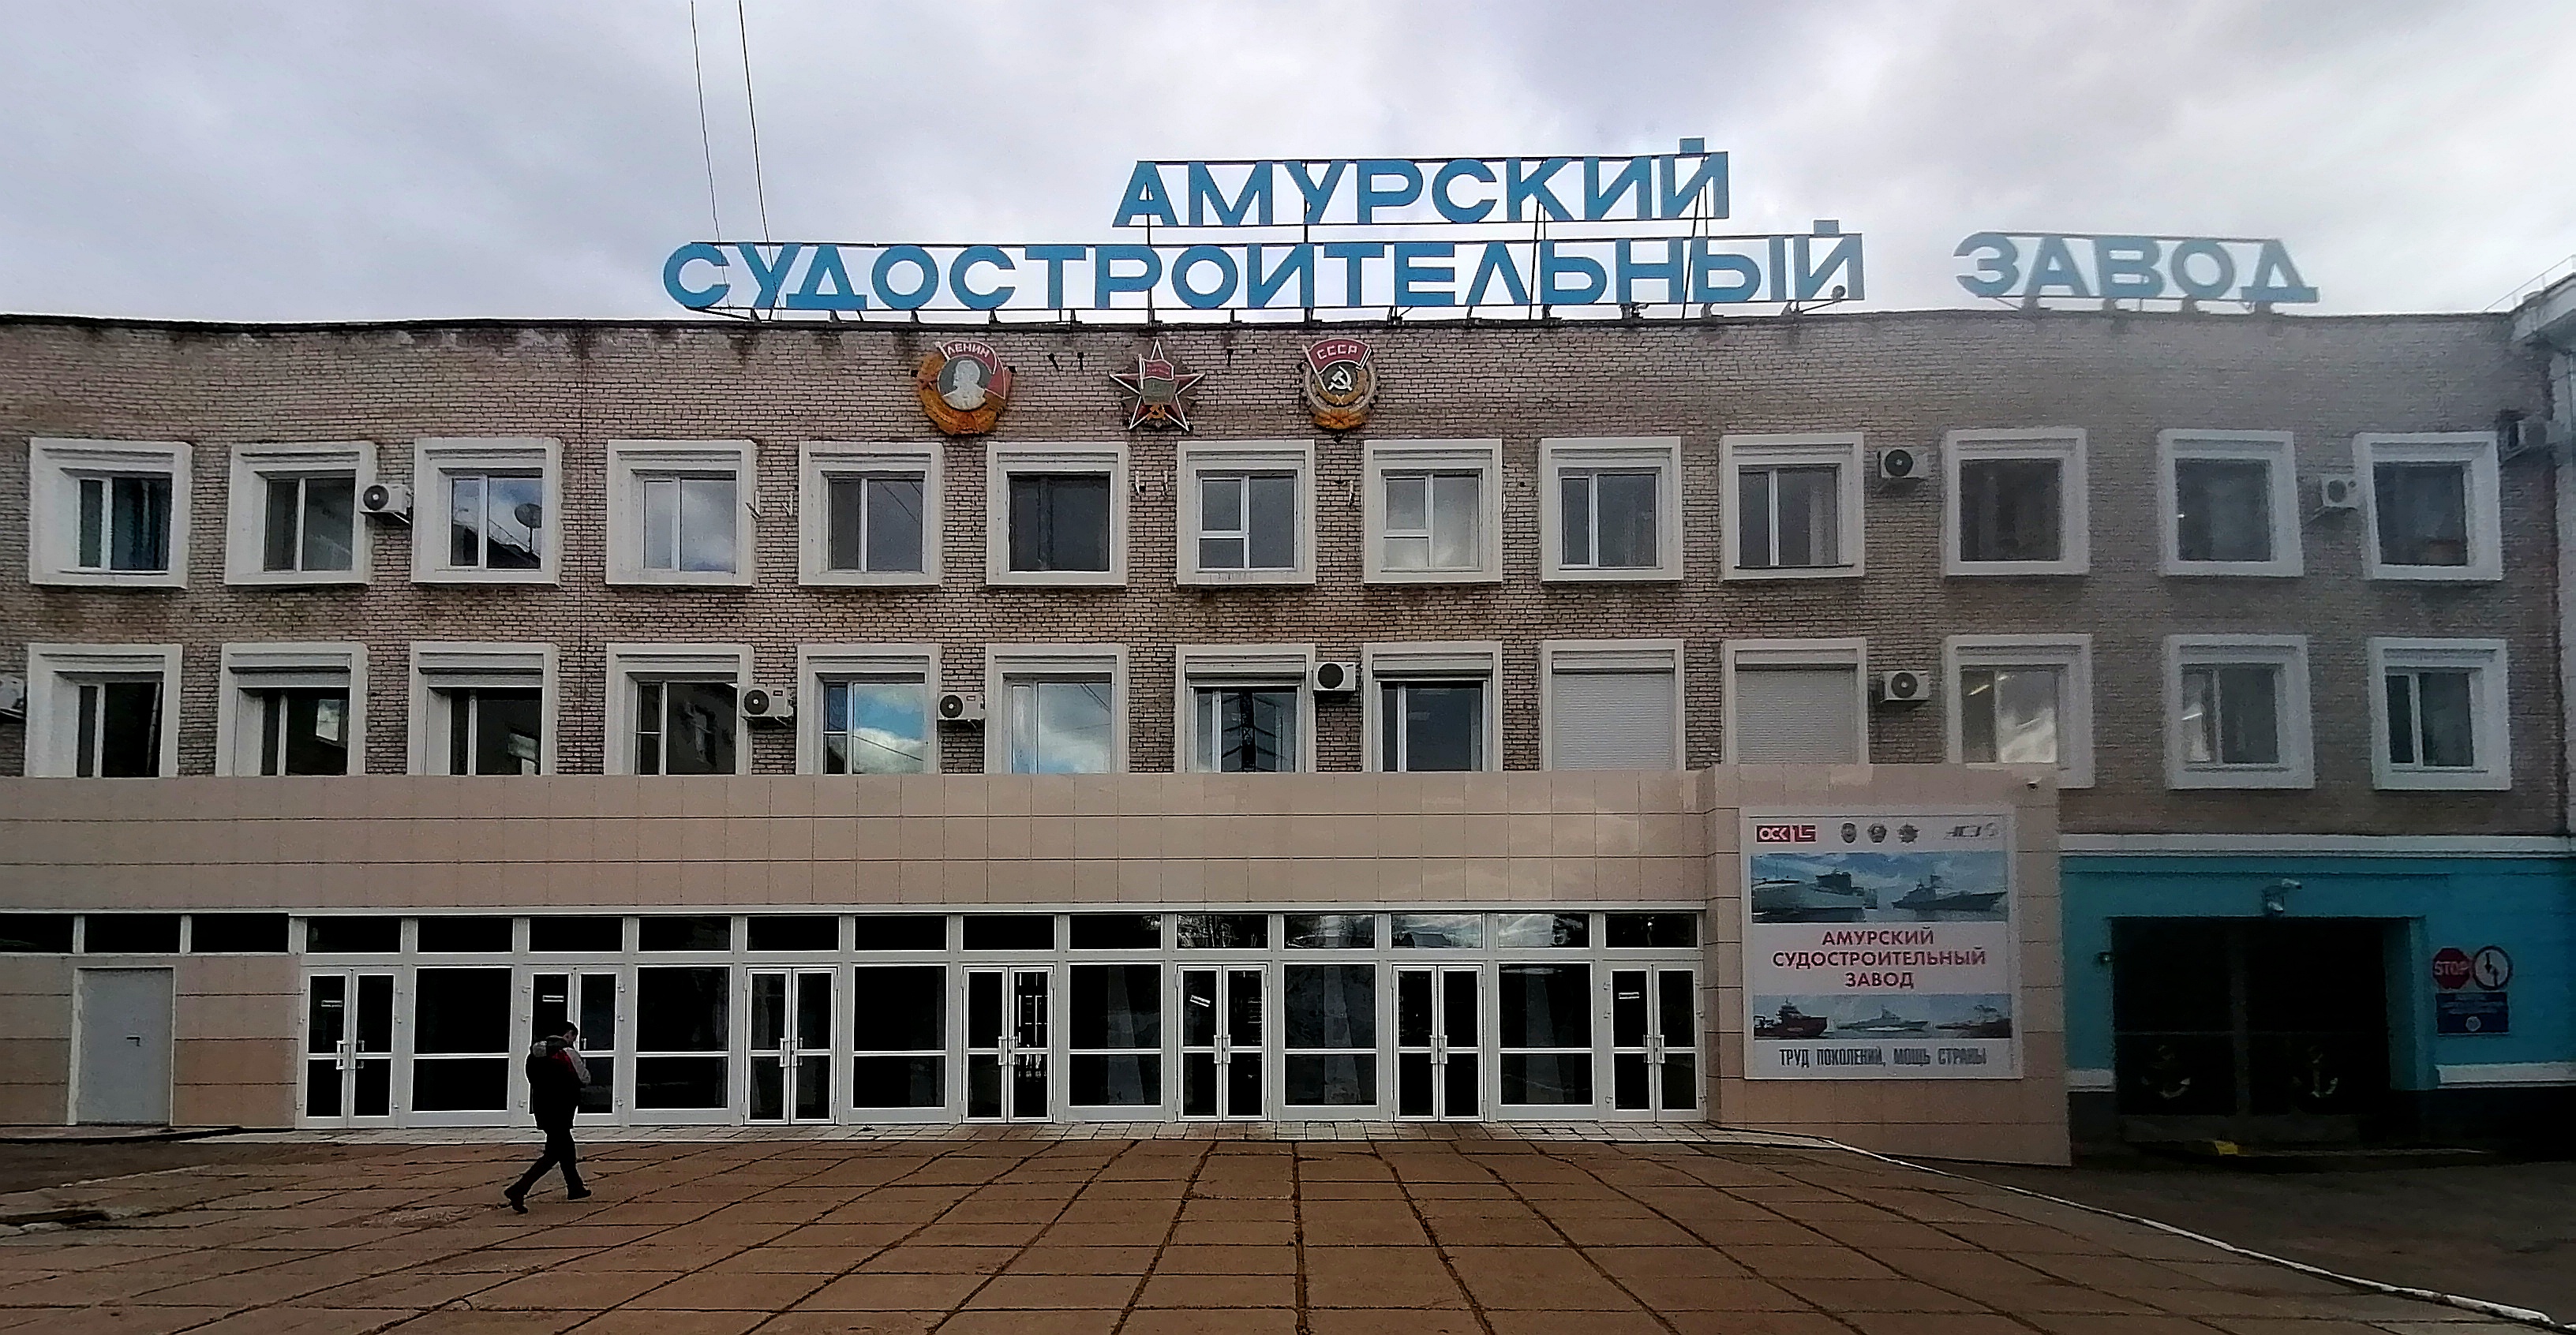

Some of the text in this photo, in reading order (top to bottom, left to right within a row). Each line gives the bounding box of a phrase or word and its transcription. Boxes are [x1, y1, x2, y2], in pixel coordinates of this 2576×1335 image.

[1112, 137, 1729, 226] АМУРСКИЙ
[663, 219, 2319, 311] СУДОСТРОИТЕЛЬНЫЙ ЗАВОД
[947, 342, 990, 357] ЛЕНИН
[1316, 344, 1357, 360] СССР
[1822, 926, 1934, 945] АМУРСКИЙ
[1773, 947, 1986, 969] СУДОСТРОИТЕЛЬНЫЙ
[2435, 961, 2469, 976] STOP
[1844, 972, 1914, 988] ЗАВОД
[1779, 1049, 1810, 1068] ТРУД
